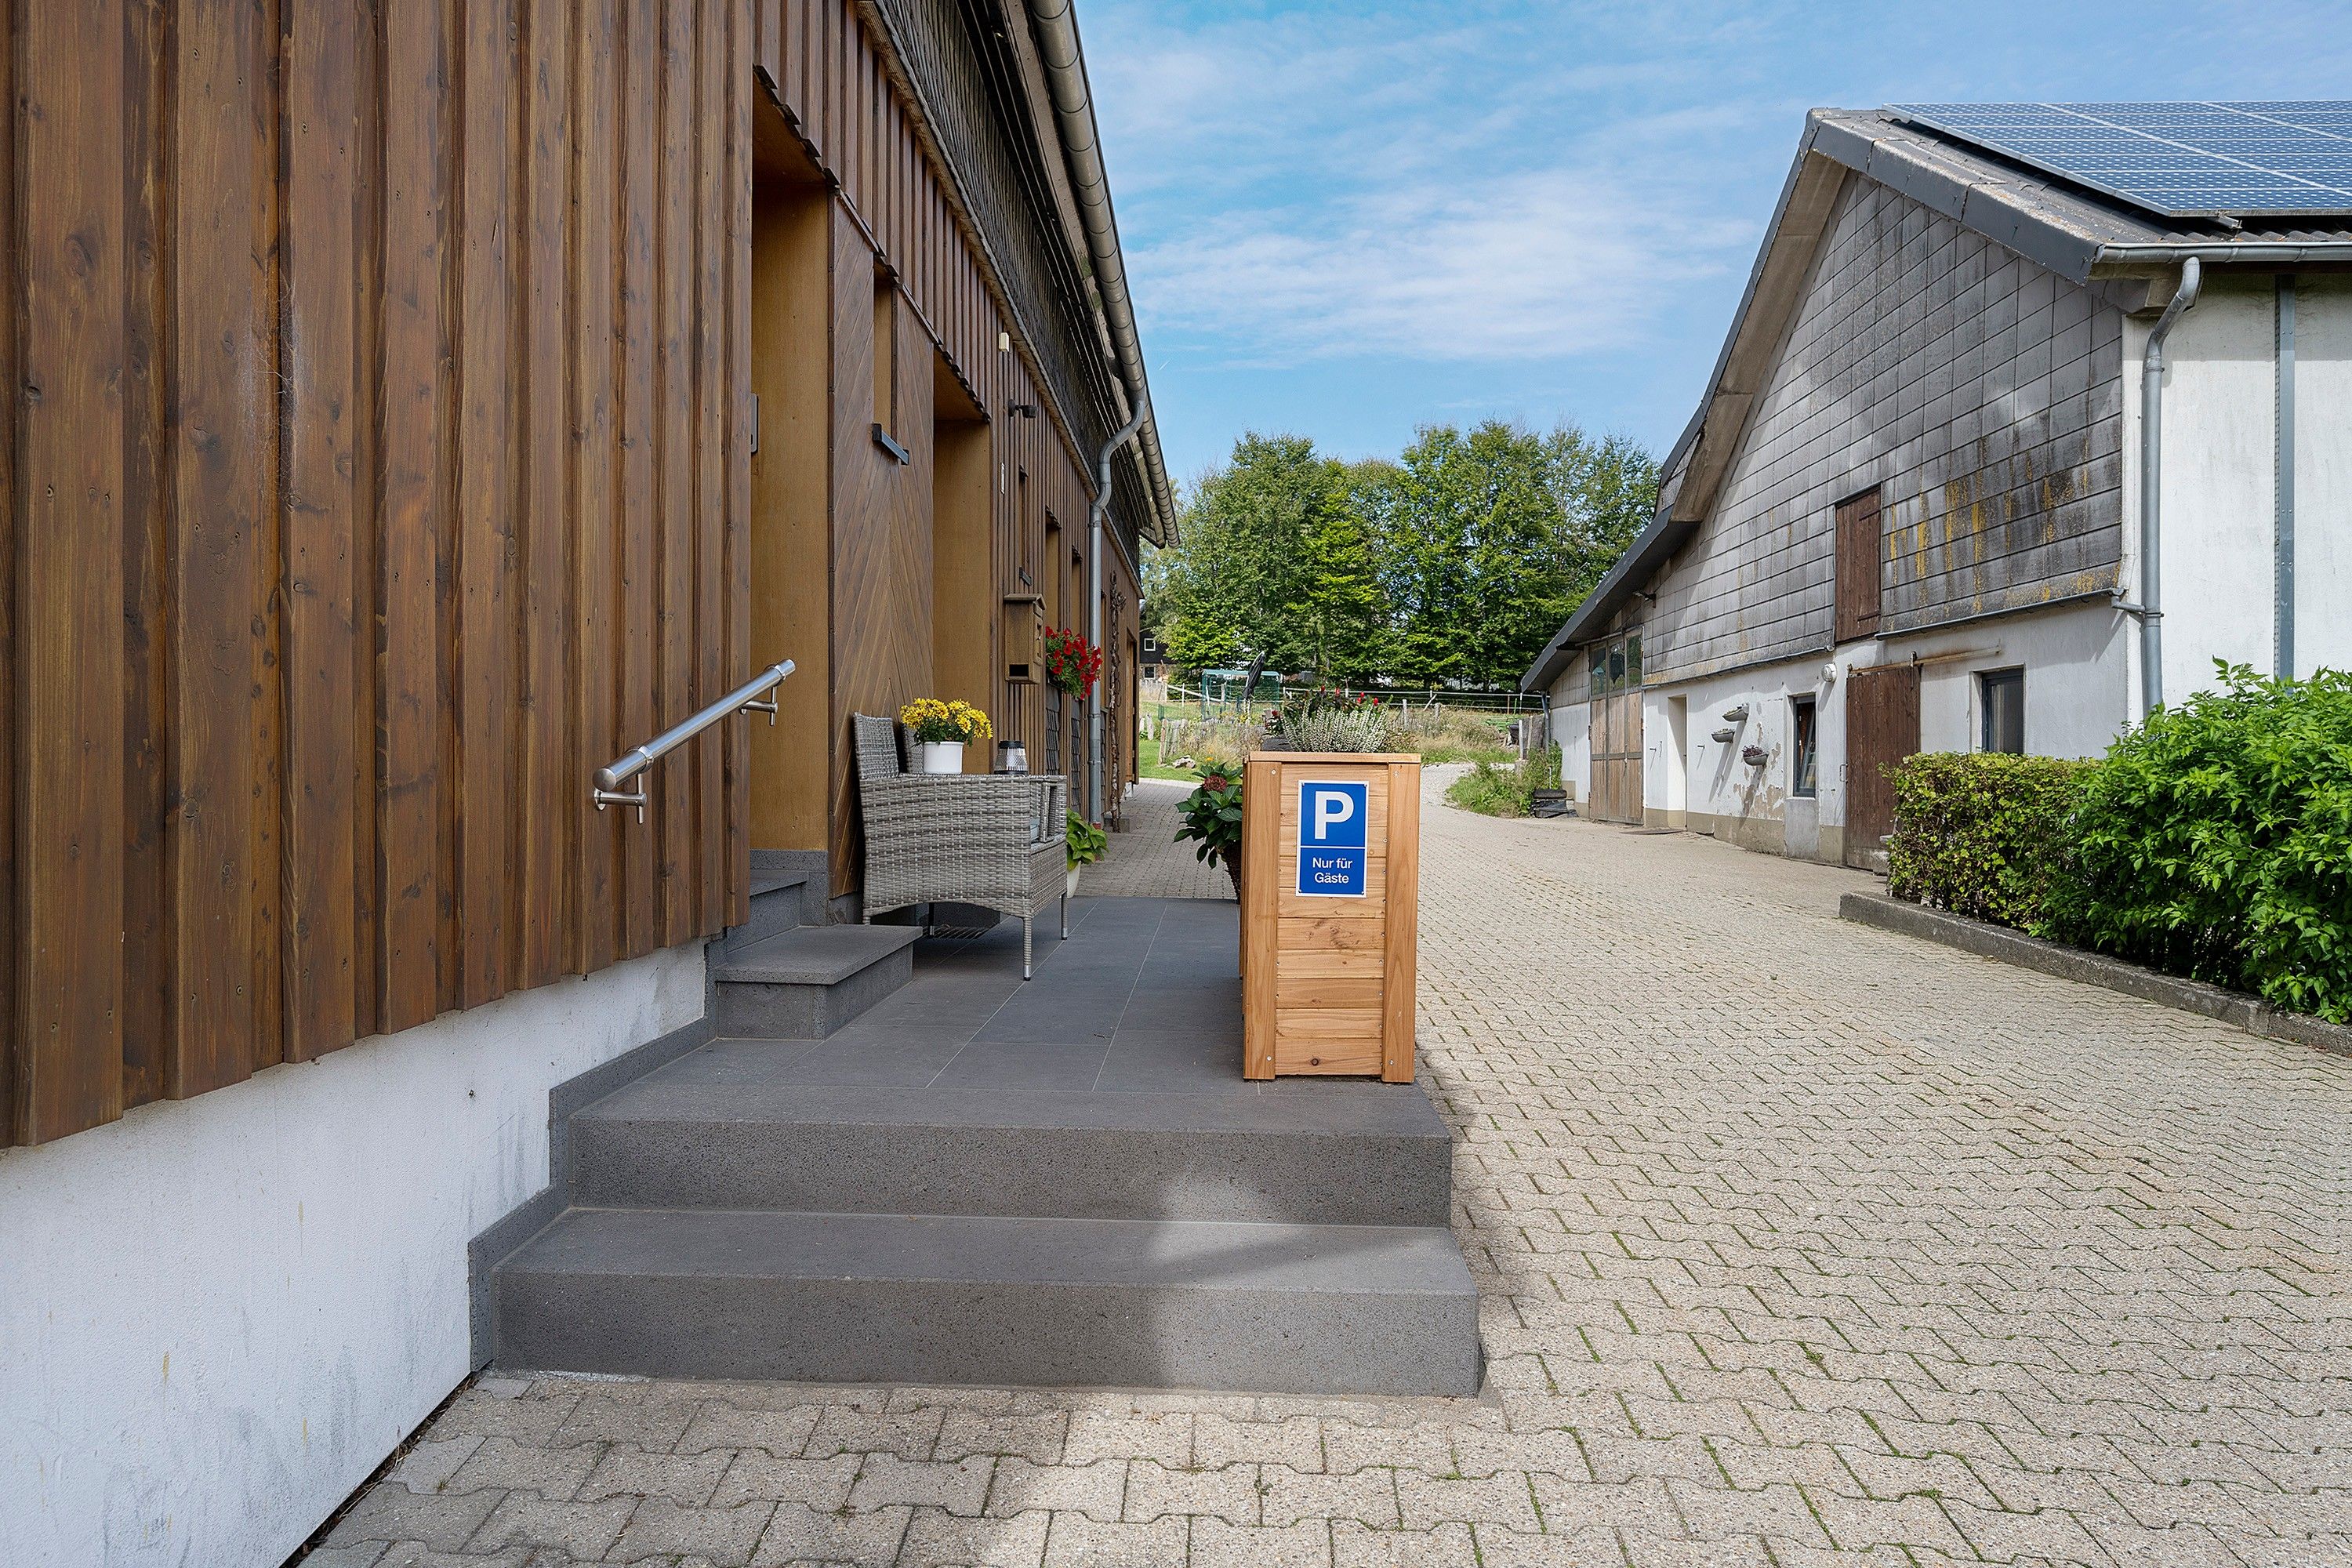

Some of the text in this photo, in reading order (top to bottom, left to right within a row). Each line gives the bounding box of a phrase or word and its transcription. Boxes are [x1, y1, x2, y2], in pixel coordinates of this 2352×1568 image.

[1314, 790, 1355, 840] P
[1312, 857, 1353, 869] Nur für
[1314, 872, 1349, 884] Gäste
